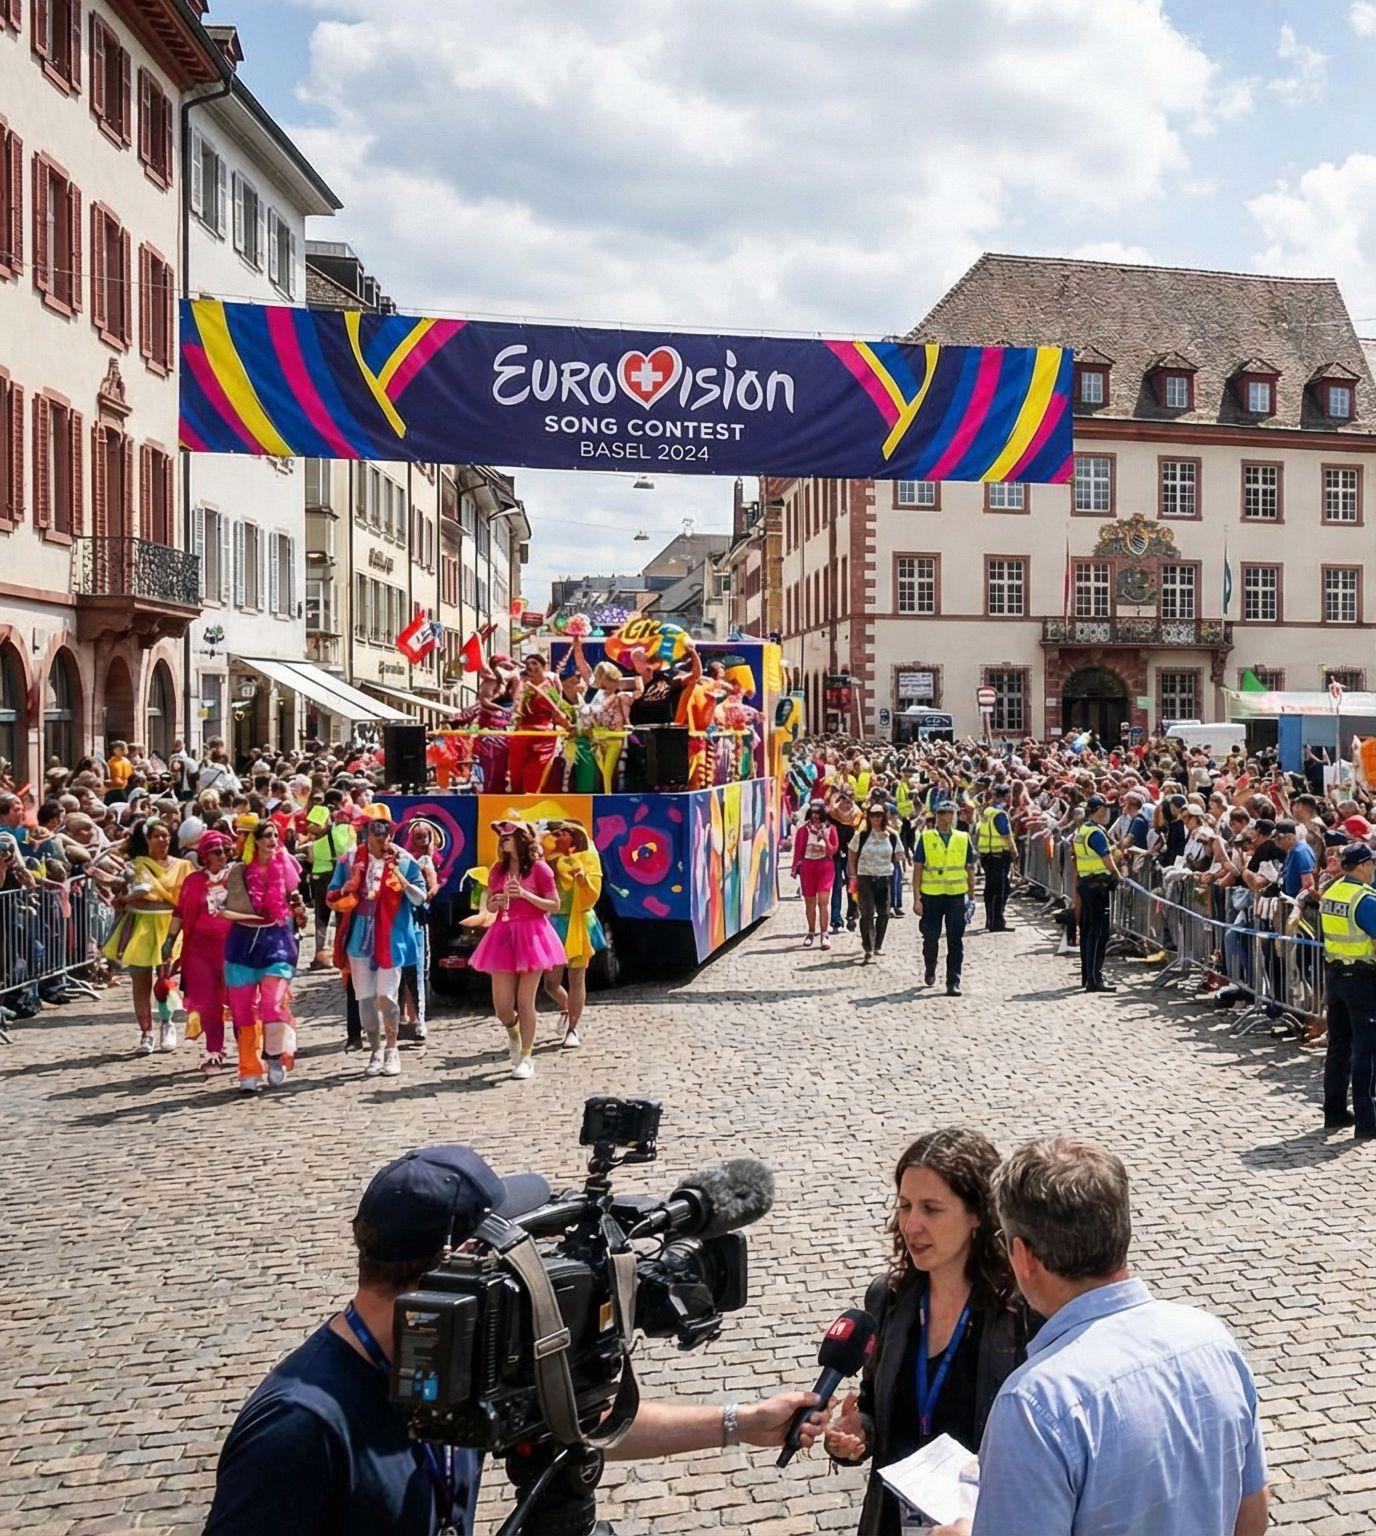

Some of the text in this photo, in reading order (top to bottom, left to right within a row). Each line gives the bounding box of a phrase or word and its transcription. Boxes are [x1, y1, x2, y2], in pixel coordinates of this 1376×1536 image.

[544, 415, 745, 441] SONG CONTEST
[580, 441, 709, 462] BASEL 2024
